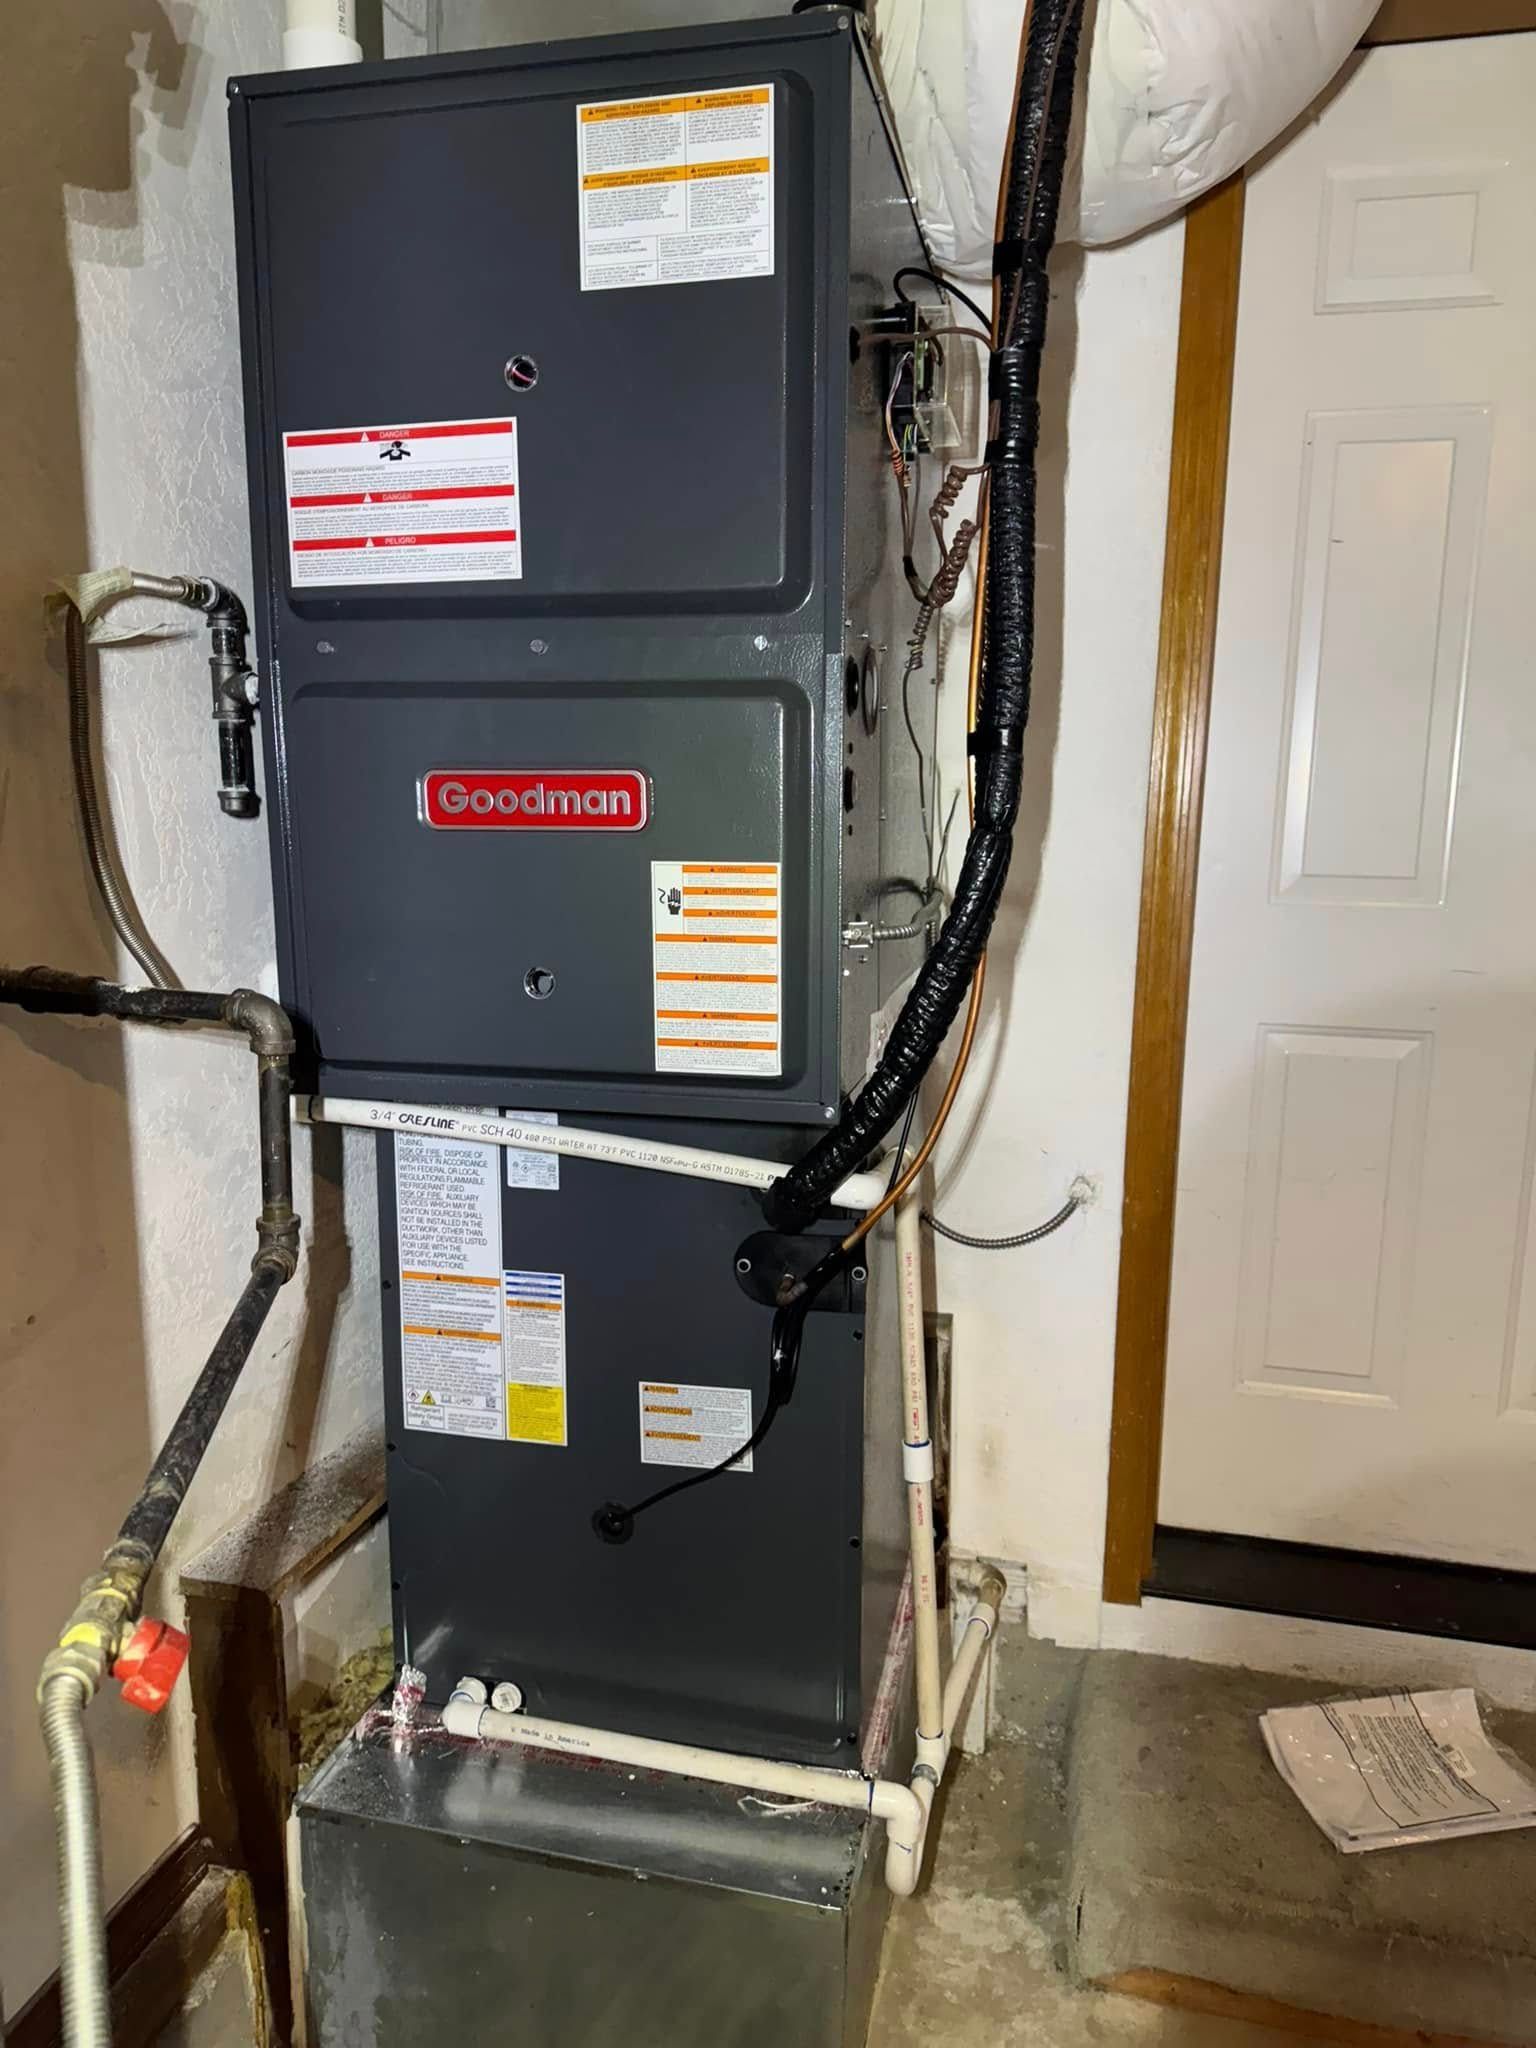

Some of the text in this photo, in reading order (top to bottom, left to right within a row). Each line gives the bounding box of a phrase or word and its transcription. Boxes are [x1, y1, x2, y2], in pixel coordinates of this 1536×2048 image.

[379, 429, 410, 439] DANGER
[381, 492, 413, 502] DANGER
[384, 536, 417, 546] PELIGRO
[438, 781, 631, 815] Goodman
[461, 1123, 478, 1134] PVC
[479, 1123, 504, 1137] SCH
[506, 1127, 523, 1140] 40
[542, 1135, 557, 1145] PSI
[557, 1138, 585, 1150] WATER
[586, 1143, 598, 1153] AT
[619, 1147, 637, 1158] PVC
[639, 1151, 659, 1162] 1120
[700, 1161, 723, 1173] ASTM
[444, 1149, 473, 1159] DISPOSE
[443, 1158, 489, 1169] ACCORDANCE
[400, 1164, 481, 1177] WITH FEDERAL OR LOCAL
[446, 1175, 486, 1186] FLAMMABLE
[400, 1182, 445, 1191] REFRIGERANT
[446, 1192, 480, 1202] AUXILIARY
[400, 1199, 477, 1211] DEVICES WHICH MAY BE
[400, 1207, 484, 1220] IGNITION SOURCES SHALL
[401, 1216, 483, 1229] NOT BE INSTALLED IN THE
[441, 1227, 465, 1236] OTHER
[465, 1228, 484, 1237] THAN
[401, 1233, 488, 1247] AUXILIARY DEVICES LISTED
[402, 1241, 462, 1253] FOR USE WITH THE
[402, 1249, 432, 1259] SPECIFIC
[403, 1258, 416, 1267] SEE
